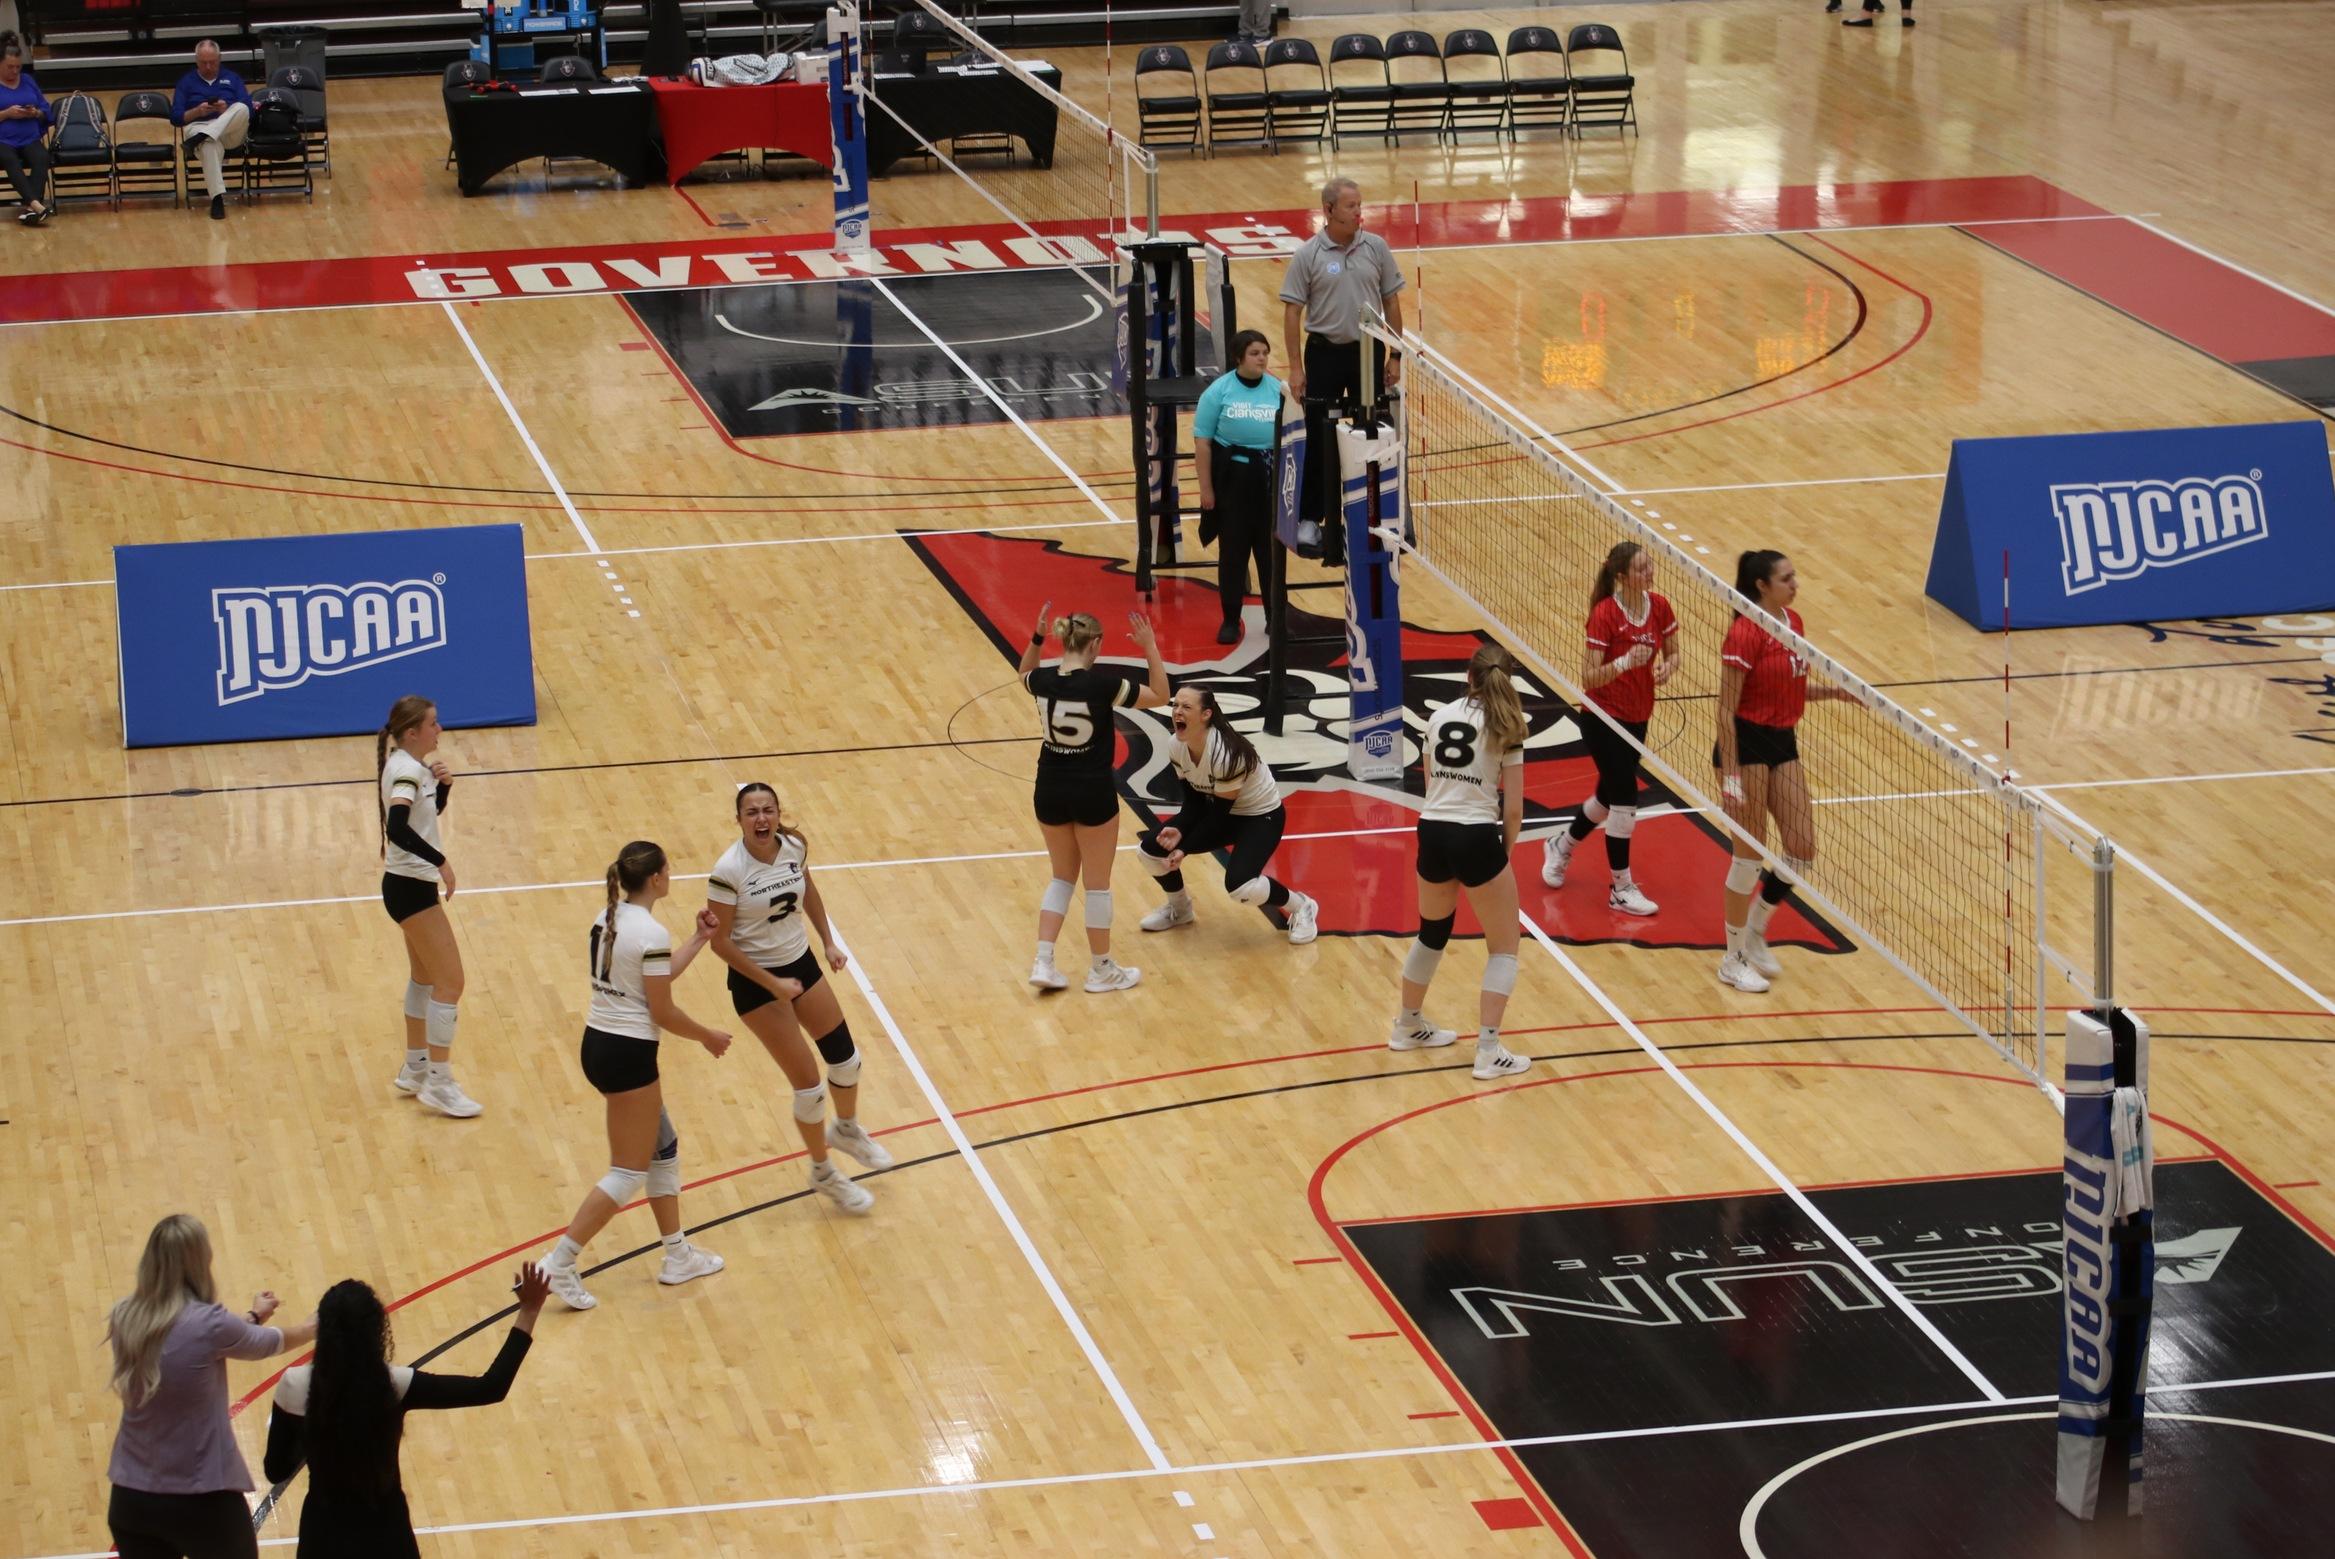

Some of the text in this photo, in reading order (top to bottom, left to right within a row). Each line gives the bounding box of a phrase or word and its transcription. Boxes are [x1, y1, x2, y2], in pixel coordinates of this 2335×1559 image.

[2062, 485, 2258, 583] NJCAA
[224, 590, 436, 692] NJCAA
[1037, 696, 1094, 747] 15
[1365, 736, 1393, 750] NJCAA
[1435, 721, 1478, 768] 8
[767, 893, 798, 923] 3
[1552, 1221, 2062, 1272] ONFERENCE
